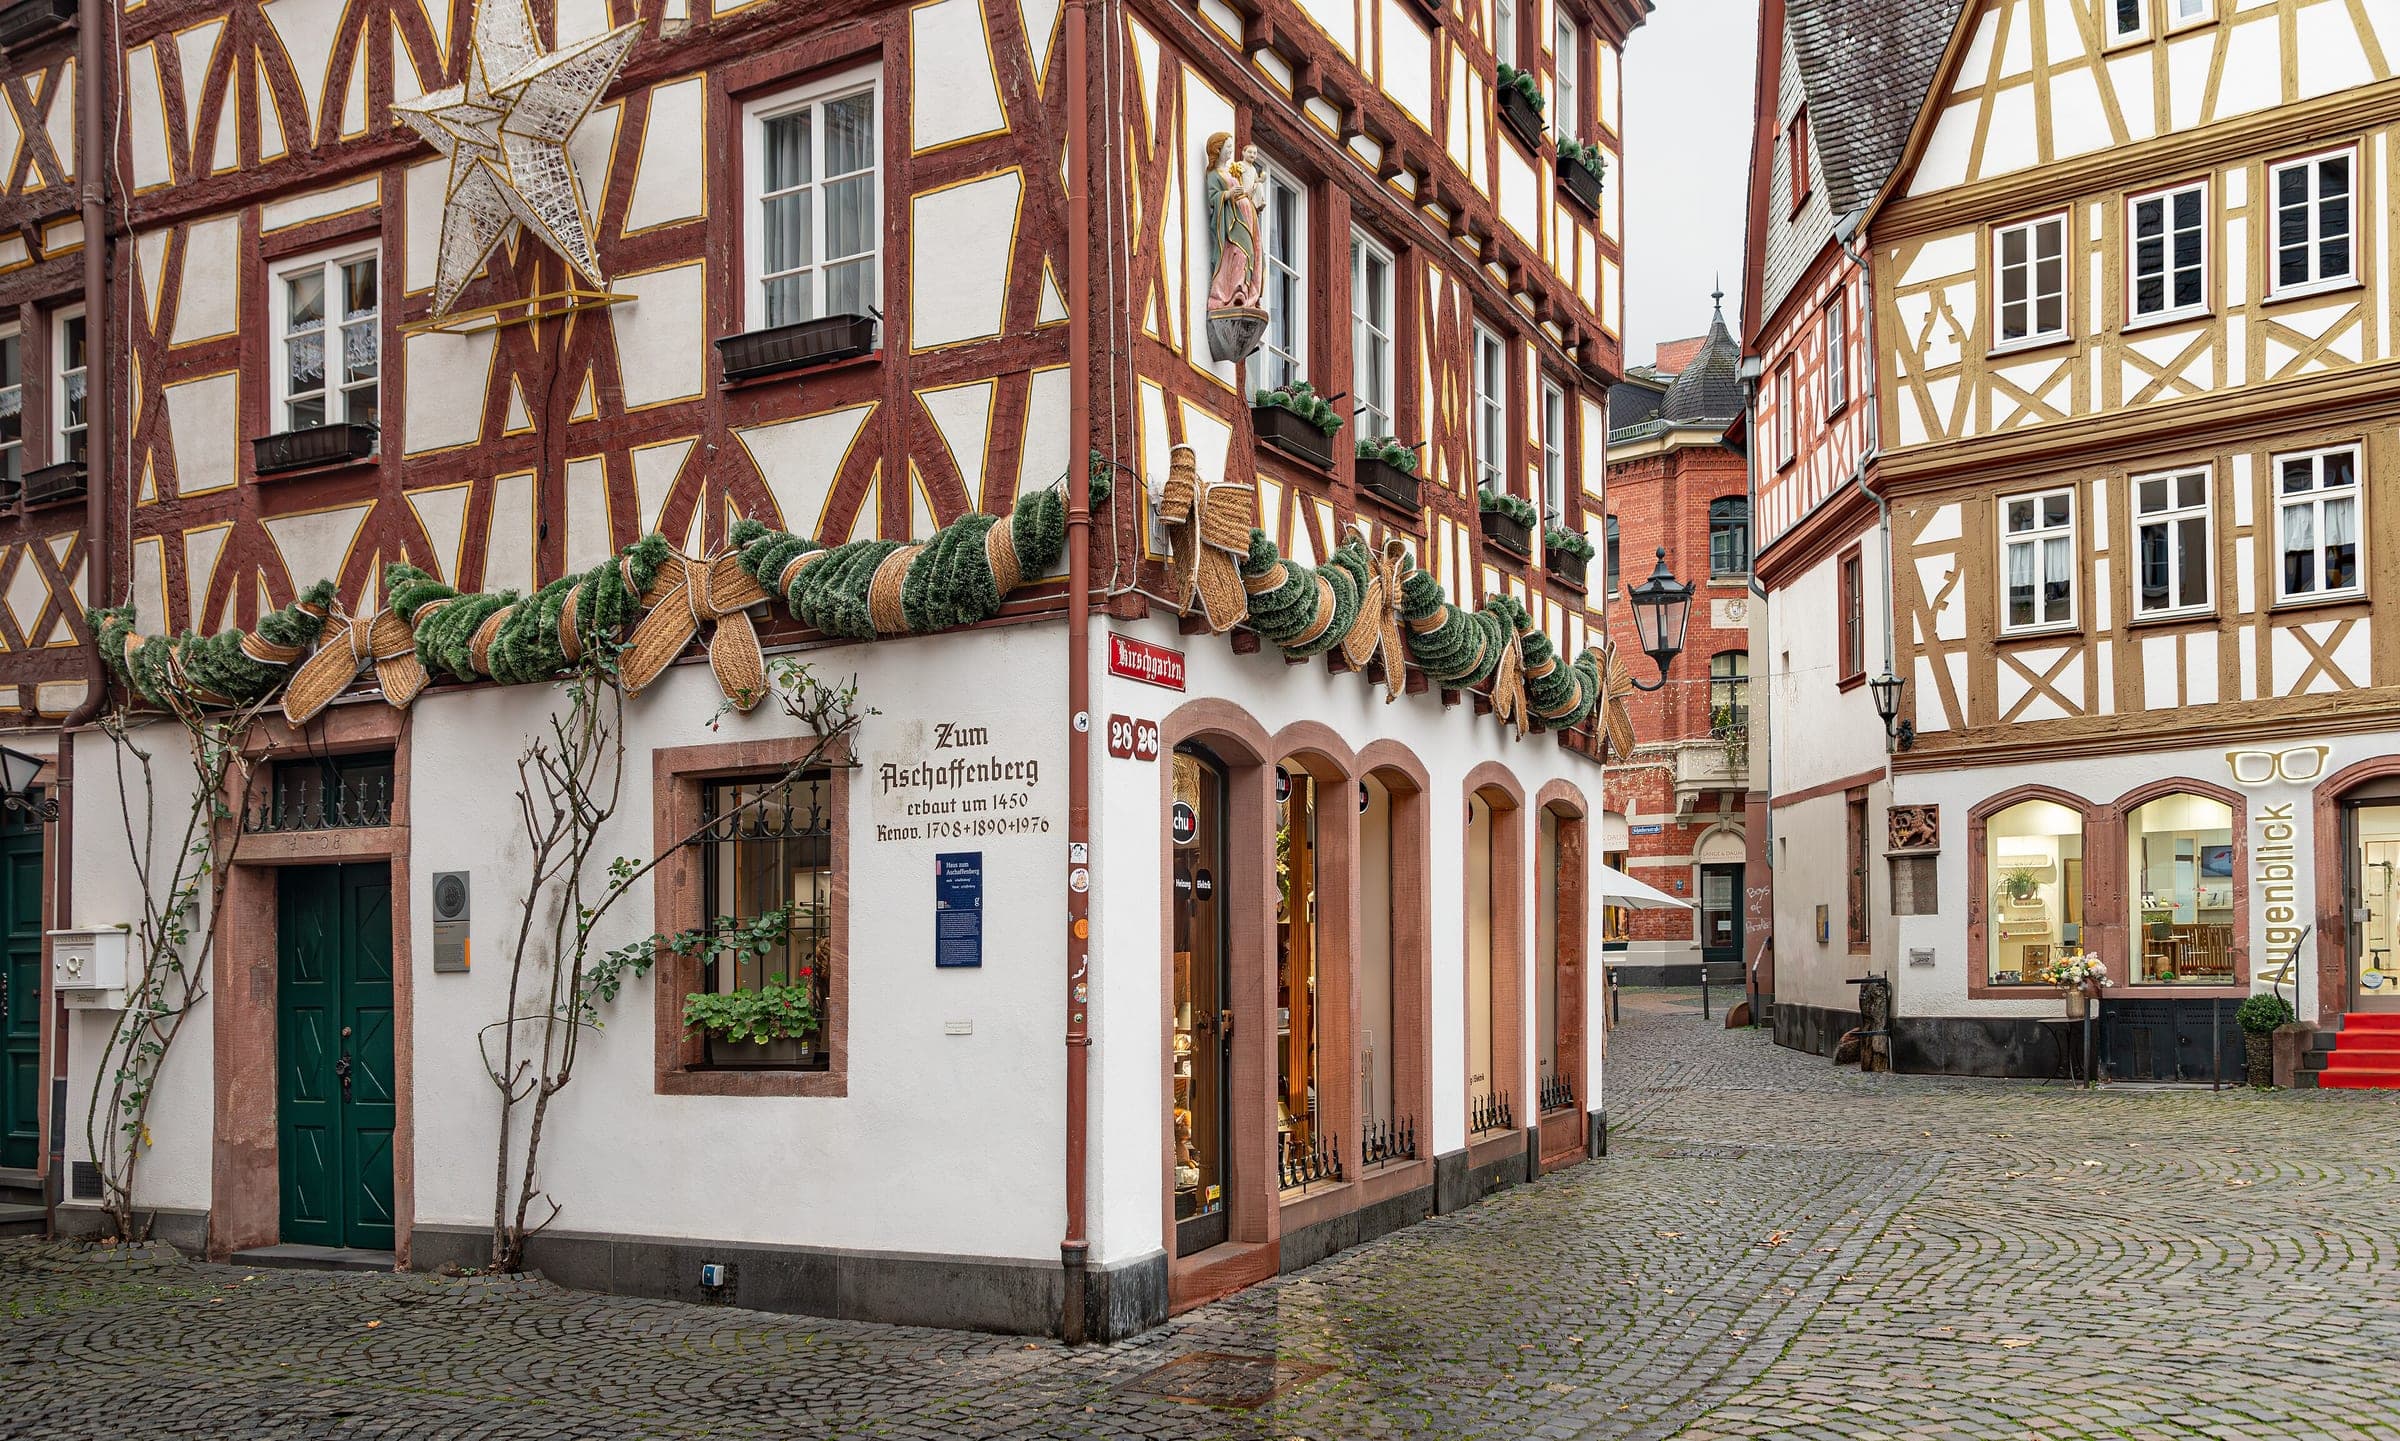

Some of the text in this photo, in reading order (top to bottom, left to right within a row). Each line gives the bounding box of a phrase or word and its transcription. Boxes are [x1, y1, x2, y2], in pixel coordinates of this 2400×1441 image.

[934, 721, 989, 750] Zum
[1111, 720, 1133, 751] 28
[1137, 724, 1158, 755] 26
[879, 755, 1039, 796] Aschaffenberg
[907, 792, 1028, 816] erbaut um 1450
[877, 823, 922, 842] Renov.
[2255, 802, 2302, 986] Augenblick
